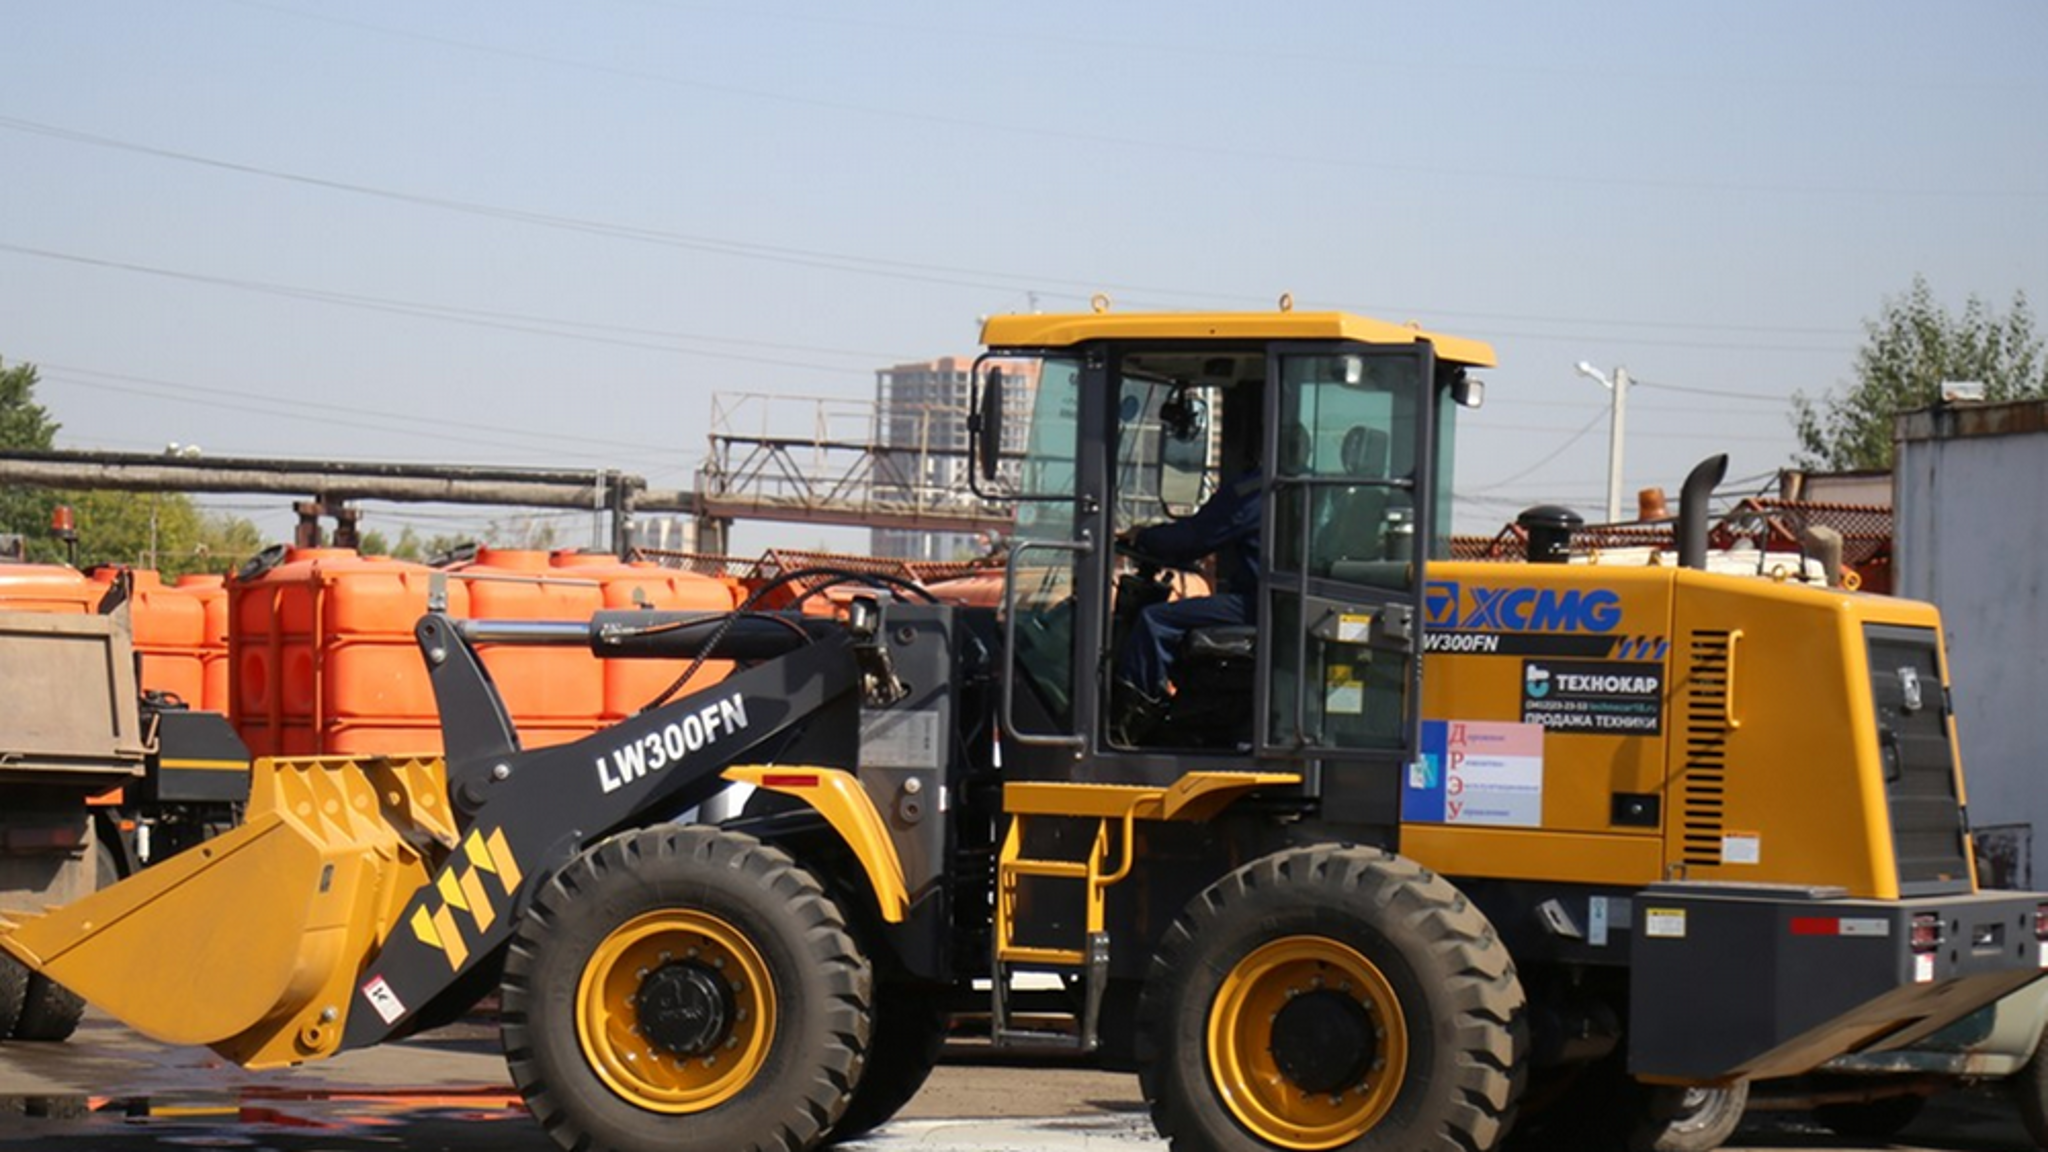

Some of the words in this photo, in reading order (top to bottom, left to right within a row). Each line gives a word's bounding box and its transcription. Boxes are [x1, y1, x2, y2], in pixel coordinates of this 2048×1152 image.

[1461, 587, 1621, 632] XCMG
[1423, 634, 1499, 652] W300FN
[1555, 674, 1658, 693] ТЕХНОКАР
[1525, 712, 1593, 729] ПРОДАЖА
[1595, 715, 1658, 729] ТЕХНИКИ
[596, 693, 748, 793] LW300FN
